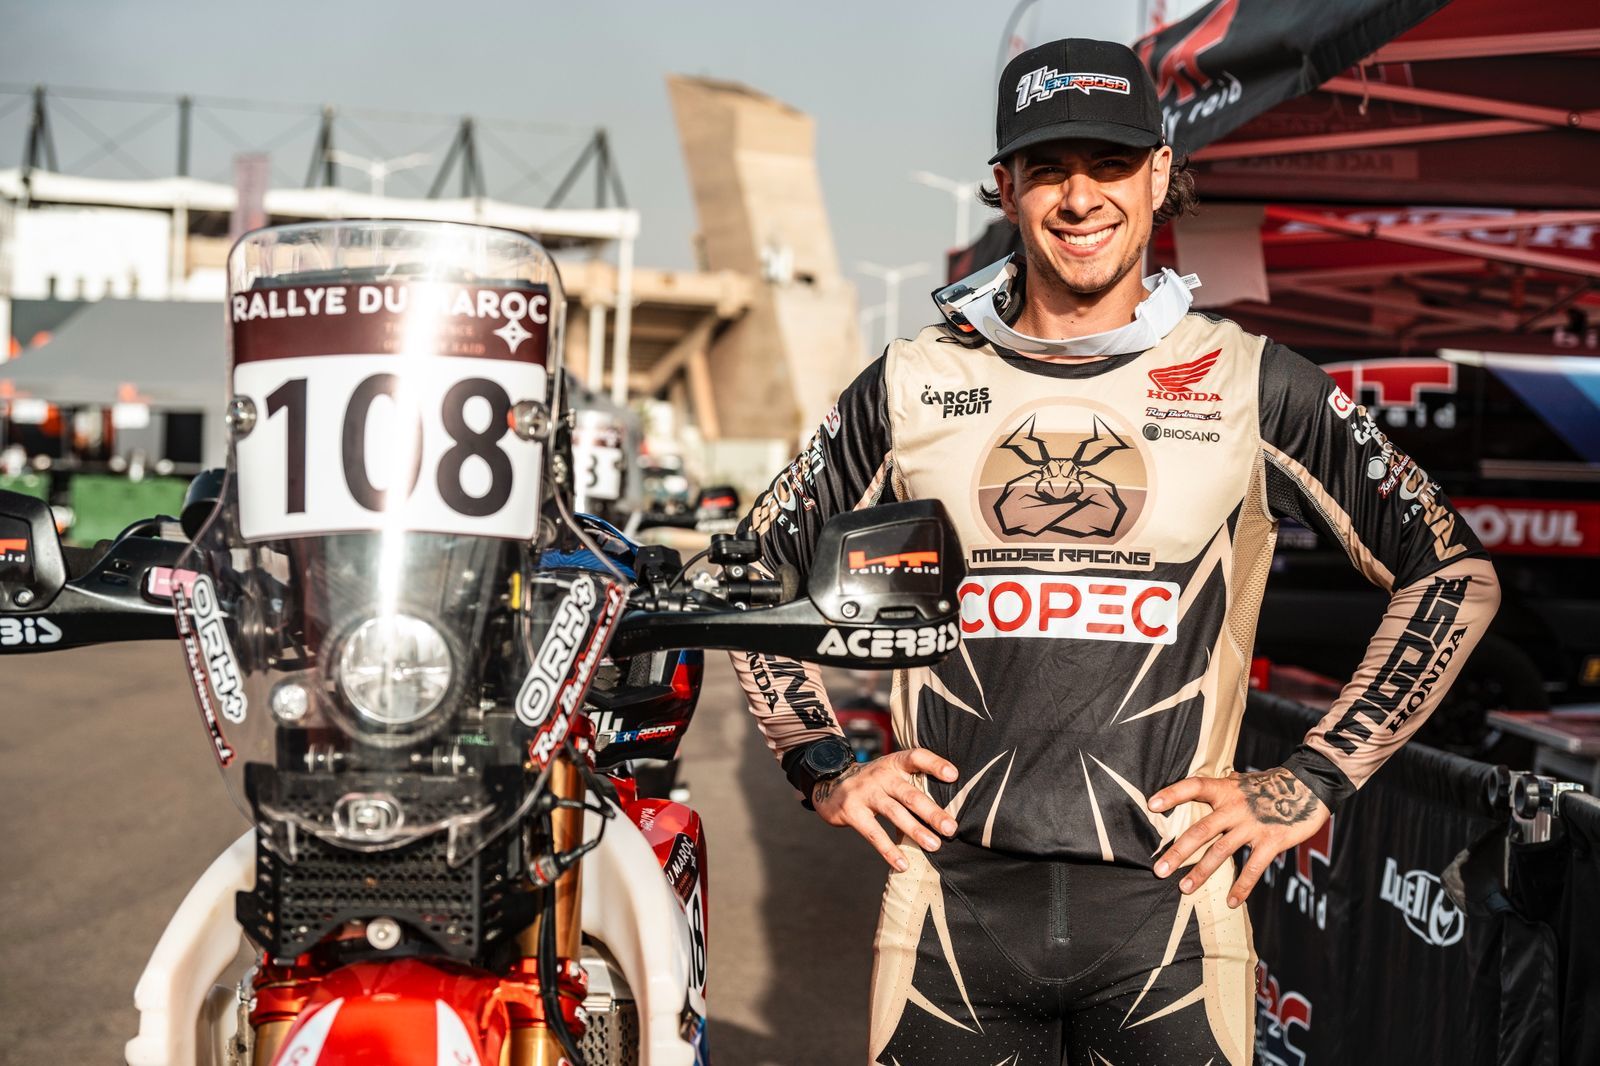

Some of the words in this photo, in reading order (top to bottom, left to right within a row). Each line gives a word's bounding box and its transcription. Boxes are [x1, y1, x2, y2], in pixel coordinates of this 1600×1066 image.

[1045, 74, 1127, 92] BARBOSA
[232, 286, 347, 322] RALLYE
[358, 285, 408, 314] DU
[412, 290, 548, 324] AROC
[943, 400, 992, 418] FRUIT
[1146, 389, 1223, 402] HONDA
[265, 373, 514, 517] 108
[1163, 428, 1220, 442] BIOSANO
[850, 565, 895, 575] rally
[904, 566, 940, 575] raid
[972, 548, 1055, 563] MOOSE
[1058, 549, 1151, 566] RACING
[958, 581, 1173, 638] COPEC
[746, 651, 779, 714] NDA
[1386, 626, 1468, 735] HONDA
[672, 836, 694, 879] MAROC
